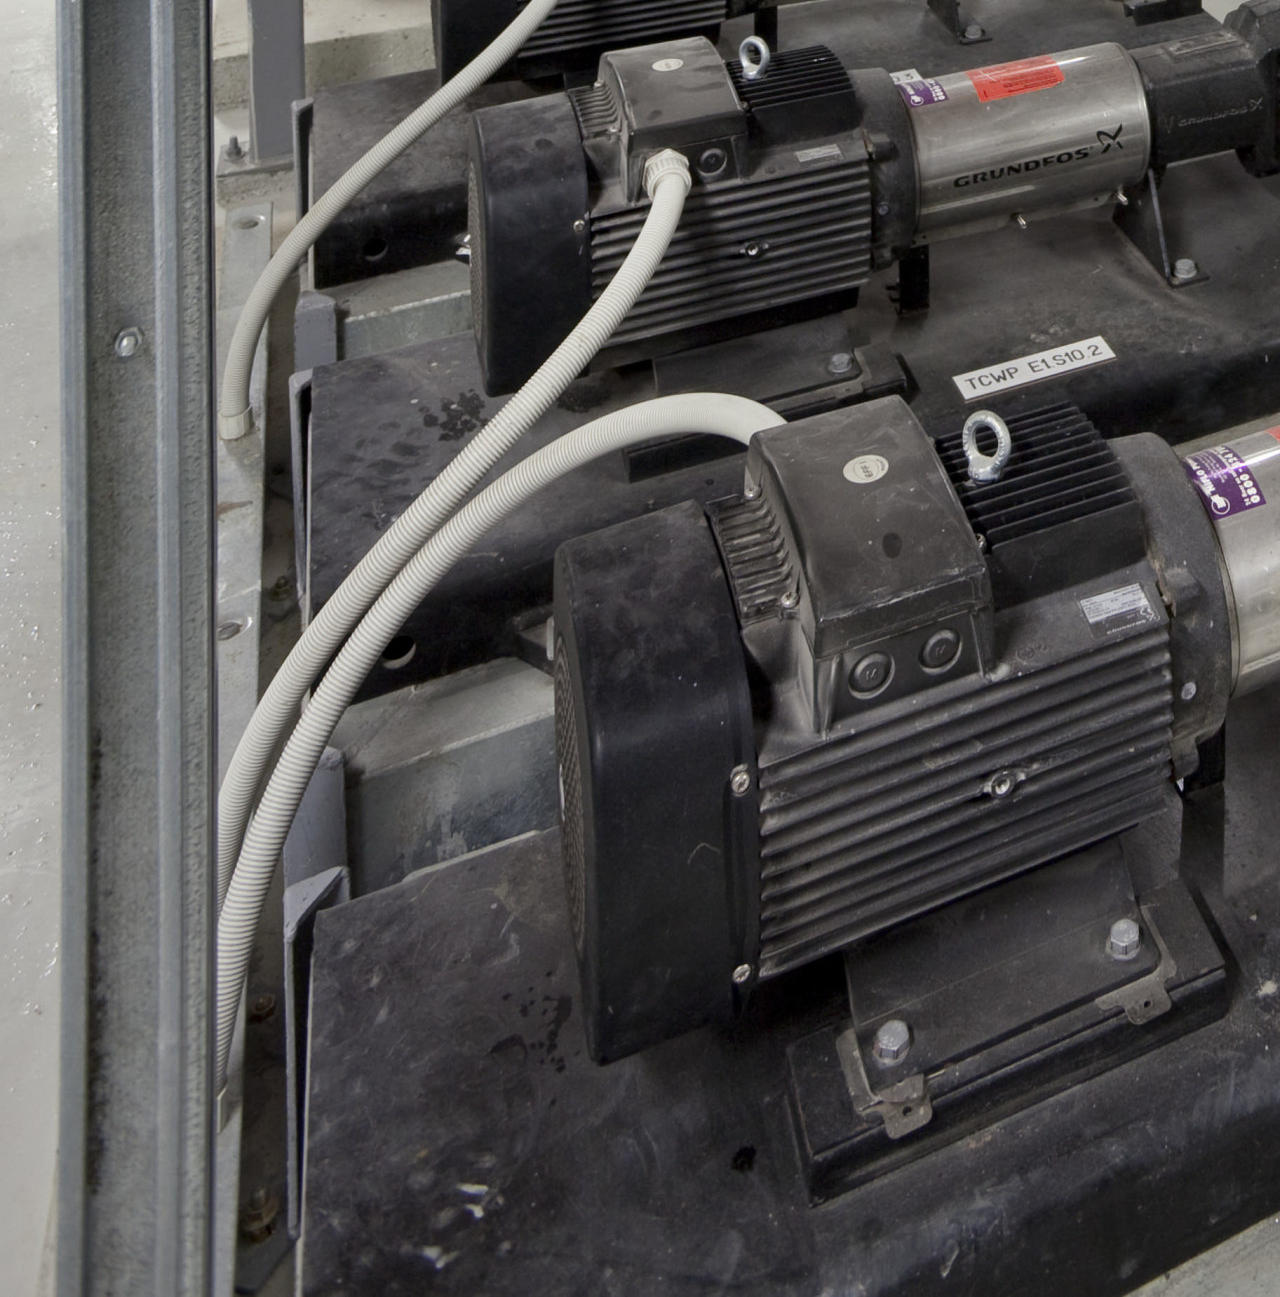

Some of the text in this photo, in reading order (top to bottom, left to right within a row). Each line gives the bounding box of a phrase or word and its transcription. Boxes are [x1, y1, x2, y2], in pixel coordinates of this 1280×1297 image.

[953, 147, 1089, 188] GRUNDFOS
[965, 344, 1103, 390] TCWP E1.S10.2
[1239, 473, 1261, 504] 0800
